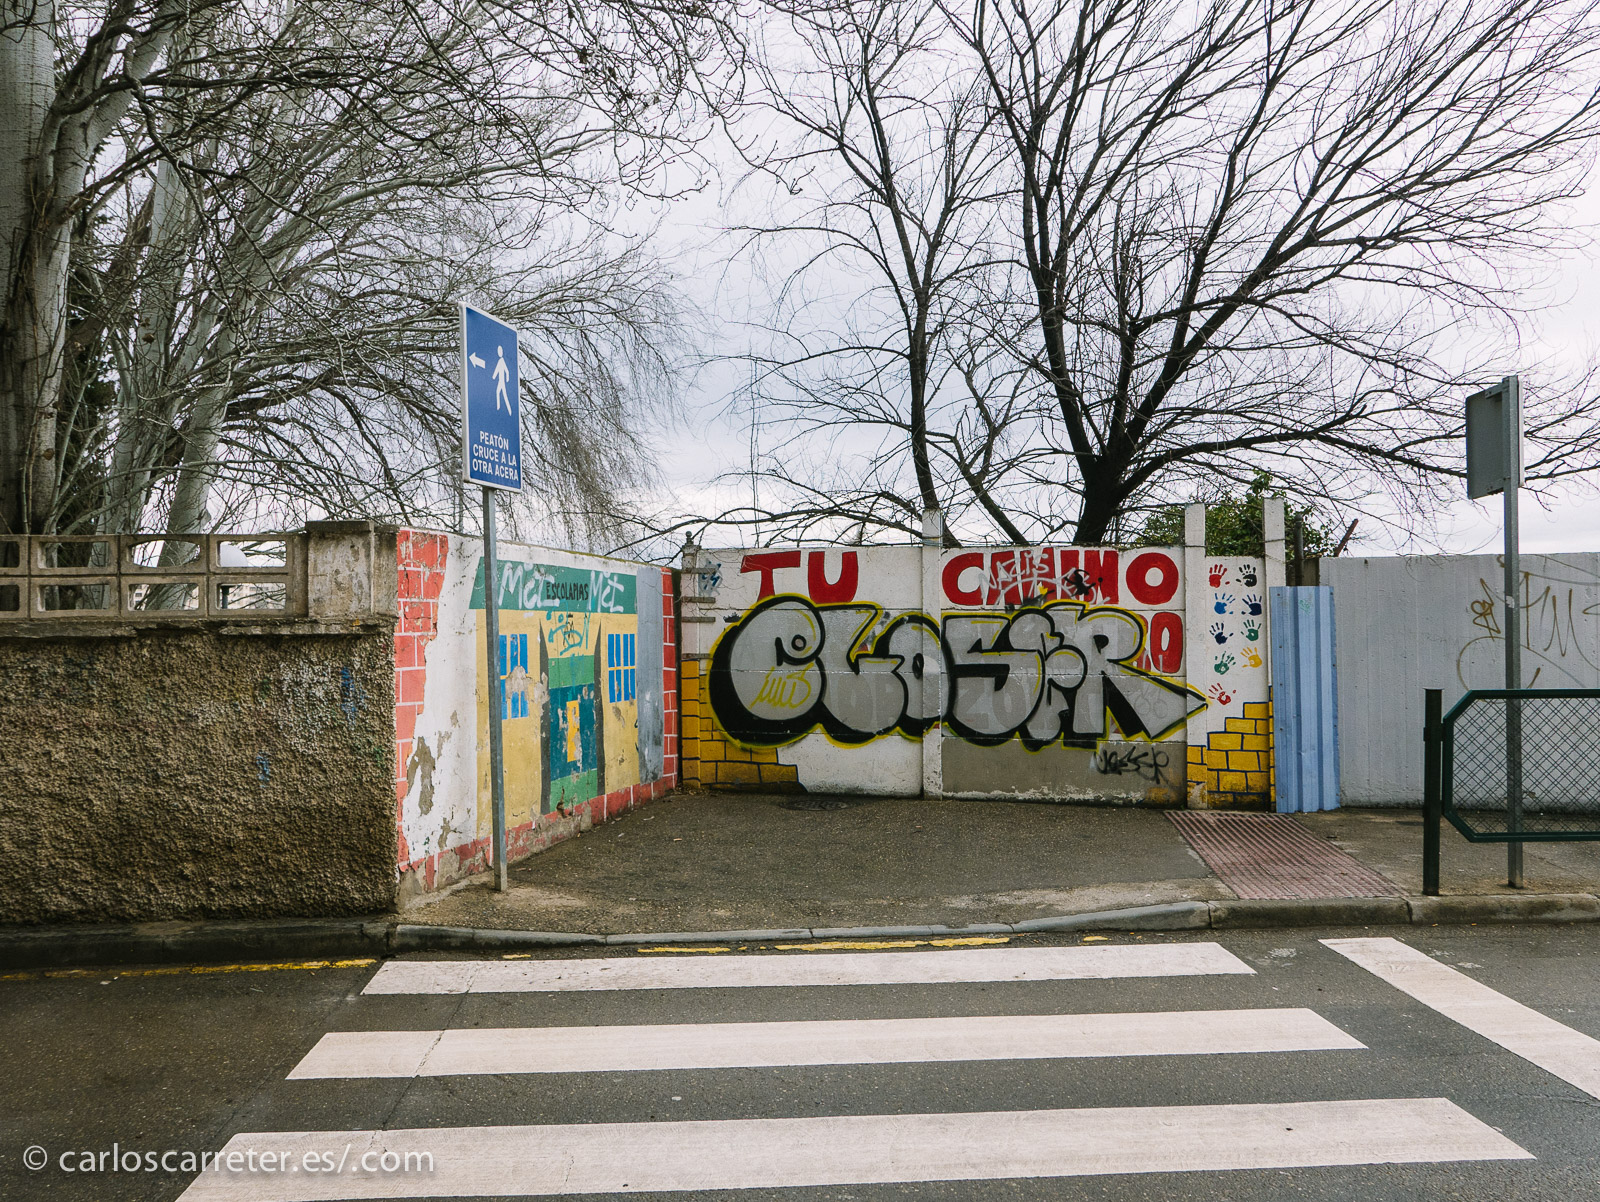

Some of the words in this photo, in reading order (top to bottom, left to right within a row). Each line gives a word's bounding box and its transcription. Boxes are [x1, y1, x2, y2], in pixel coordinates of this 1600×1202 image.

[480, 431, 509, 450] PEATÓN
[473, 444, 499, 462] CRUCE
[501, 452, 506, 464] A
[508, 453, 517, 466] LA
[473, 459, 493, 475] OTRA
[495, 465, 518, 481] ACERA
[740, 550, 858, 604] TU
